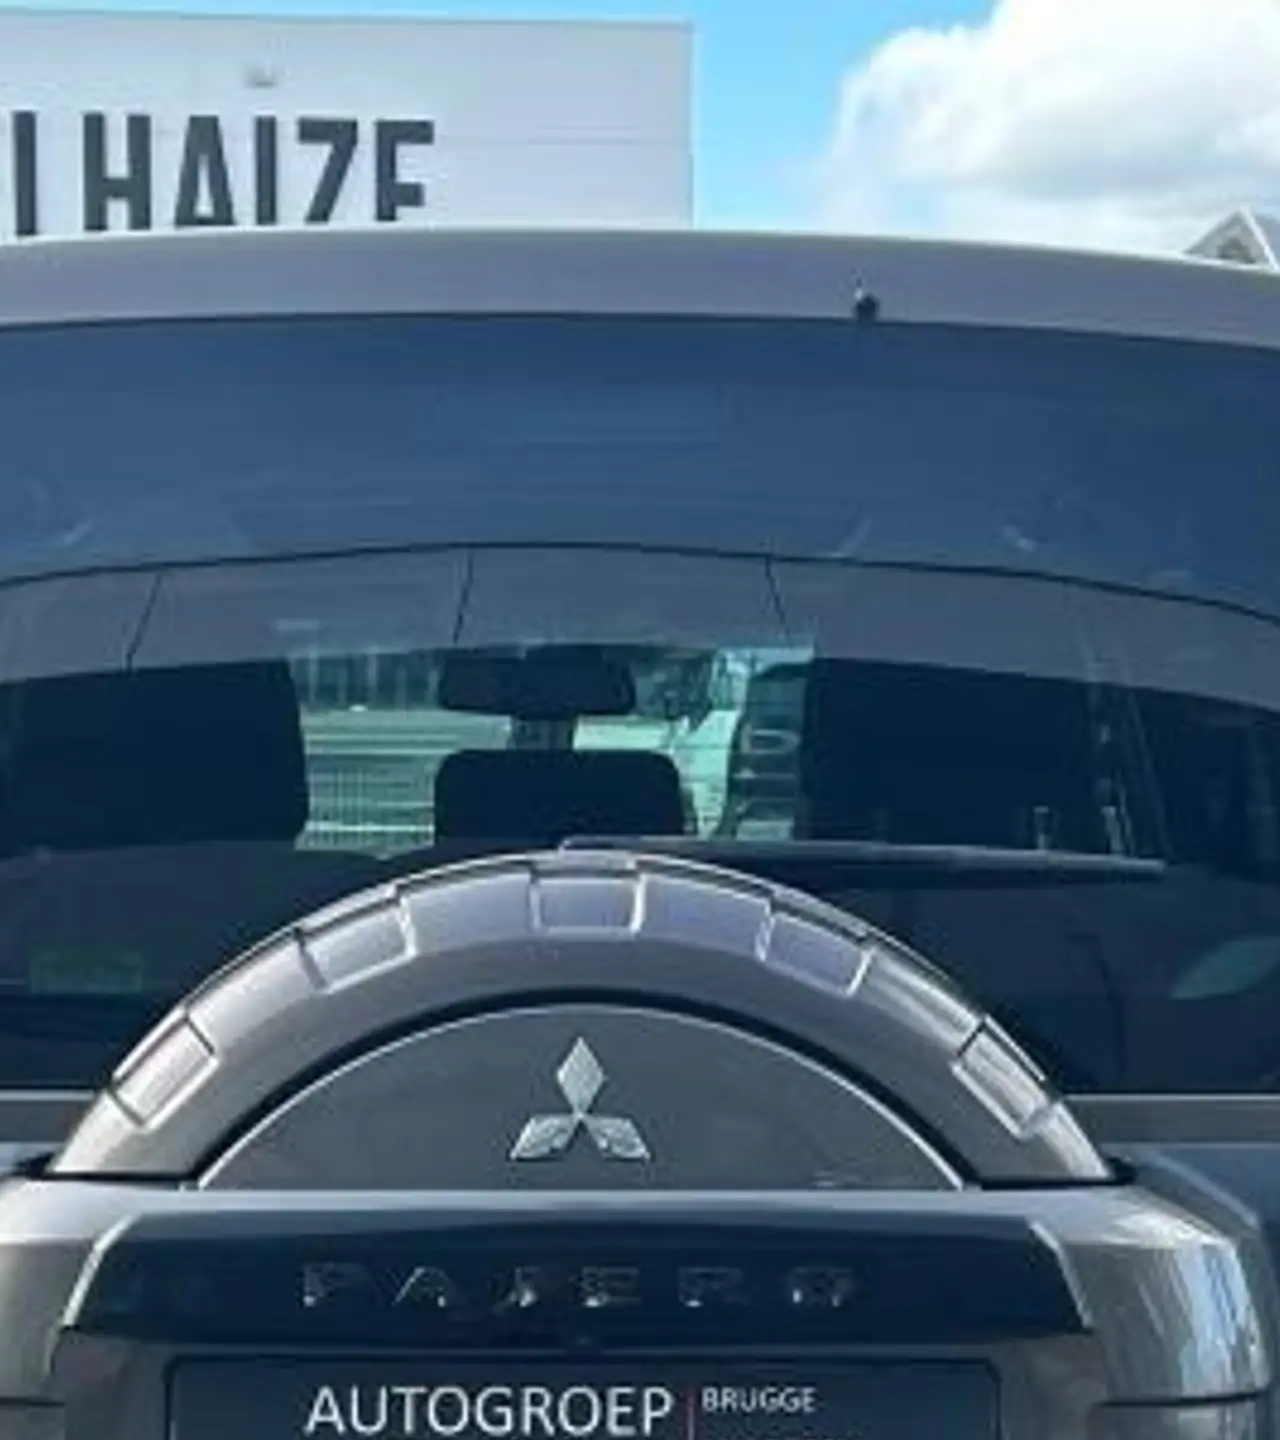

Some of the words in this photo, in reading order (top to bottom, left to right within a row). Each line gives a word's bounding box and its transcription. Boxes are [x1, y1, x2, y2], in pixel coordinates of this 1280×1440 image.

[302, 1261, 854, 1307] PAJERO
[303, 1385, 675, 1436] AUTOGROEP
[701, 1386, 817, 1413] BRUGGE
